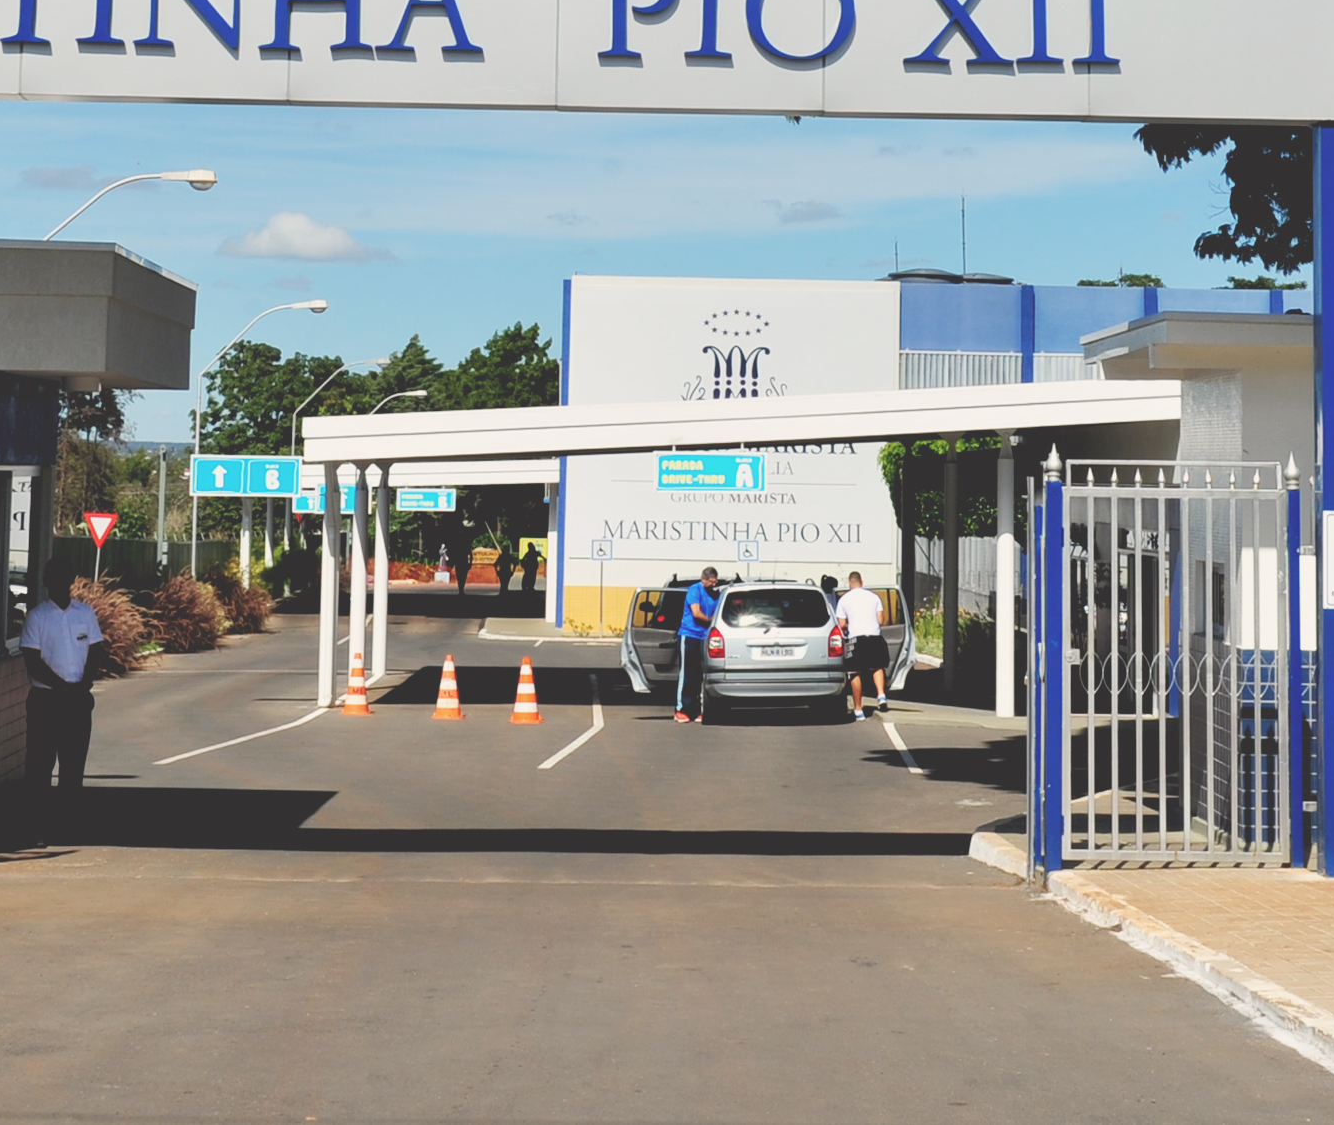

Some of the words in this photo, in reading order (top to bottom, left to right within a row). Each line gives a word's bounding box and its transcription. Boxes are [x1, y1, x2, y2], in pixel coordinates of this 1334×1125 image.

[661, 459, 704, 471] PARADA
[735, 463, 754, 488] A
[670, 492, 724, 504] GRUPO
[729, 493, 797, 505] MARISTA
[601, 519, 769, 543] MARISTINHA
[777, 522, 820, 543] PIO
[827, 523, 862, 543] XII
